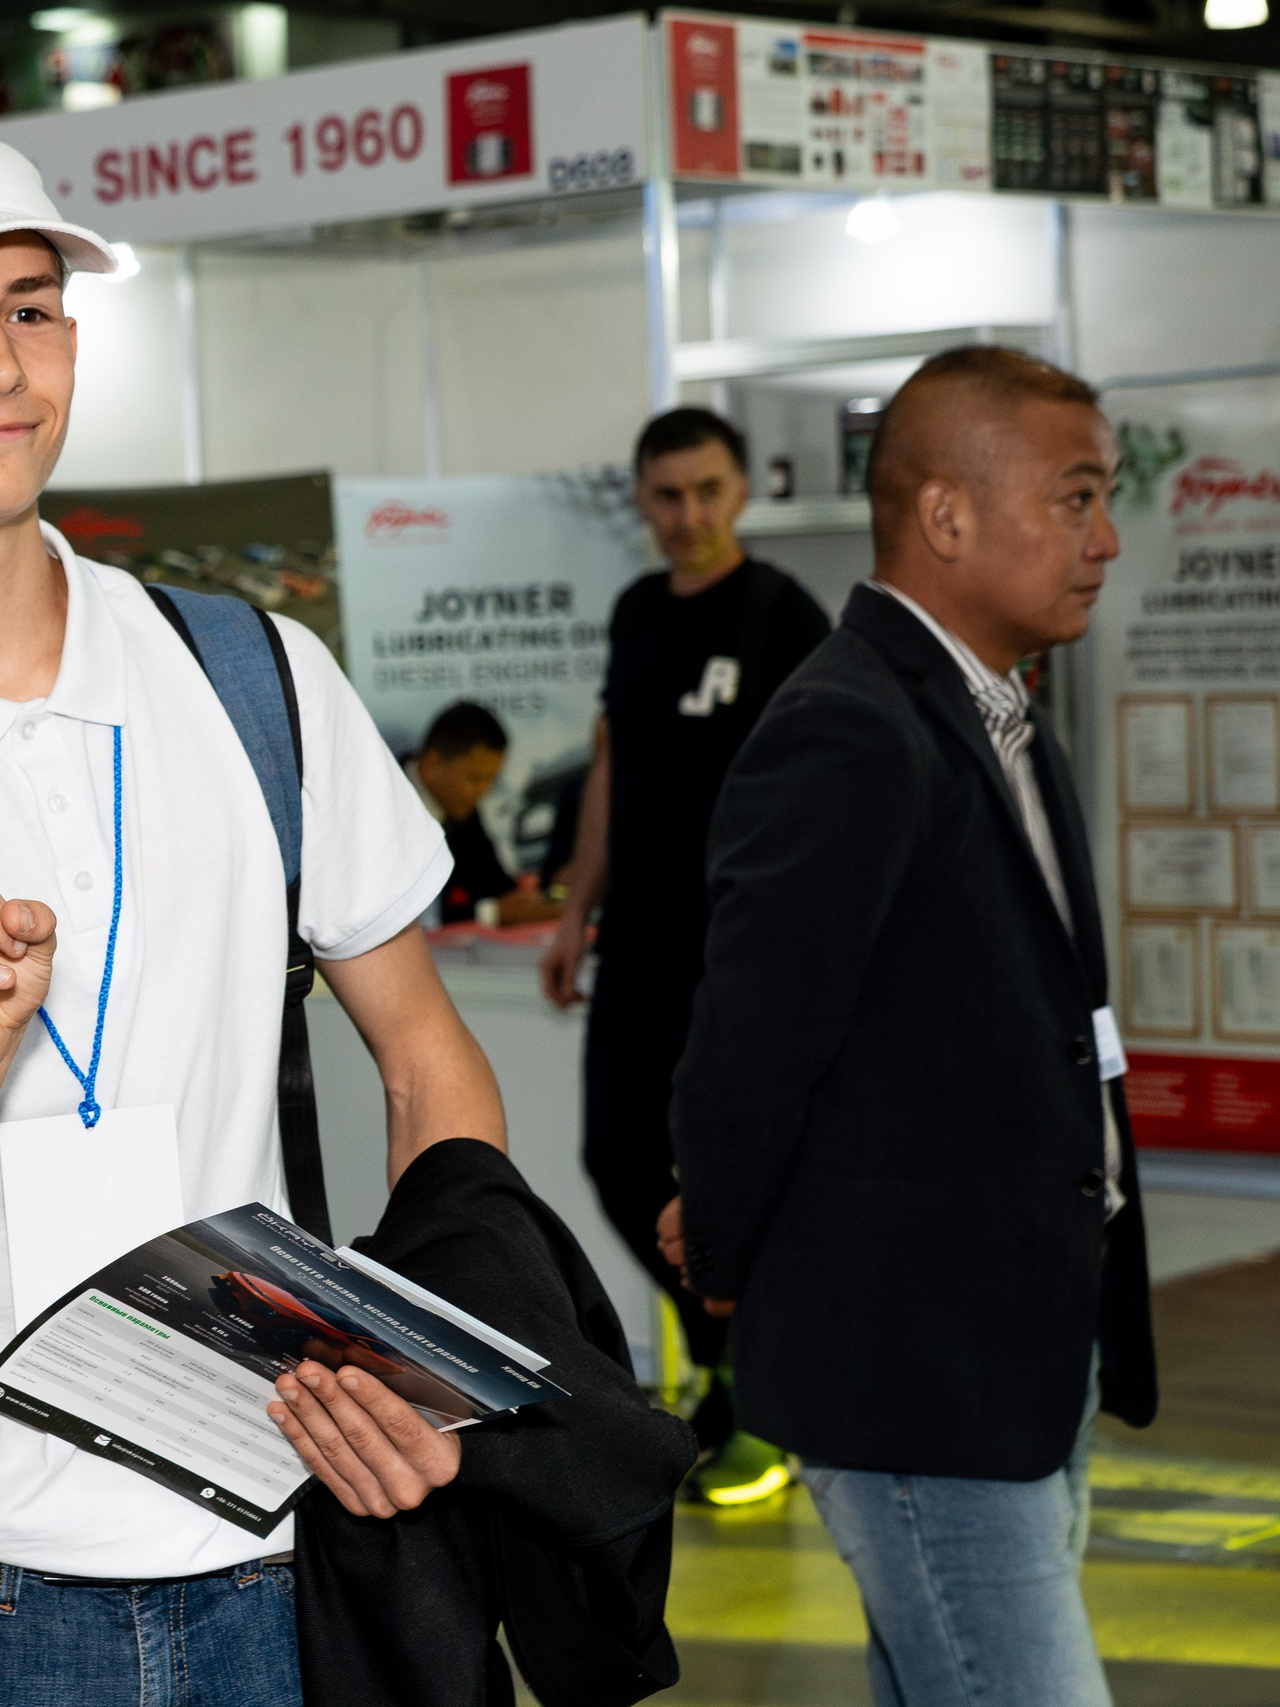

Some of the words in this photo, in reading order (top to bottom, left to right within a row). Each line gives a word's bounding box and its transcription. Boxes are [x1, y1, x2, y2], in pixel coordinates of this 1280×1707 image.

[94, 129, 257, 204] SINCE
[286, 104, 425, 176] 1960
[1174, 546, 1278, 583] JOYNE
[416, 581, 573, 623] JOYNER
[89, 1295, 128, 1318] Основные
[126, 1314, 170, 1340] параметры
